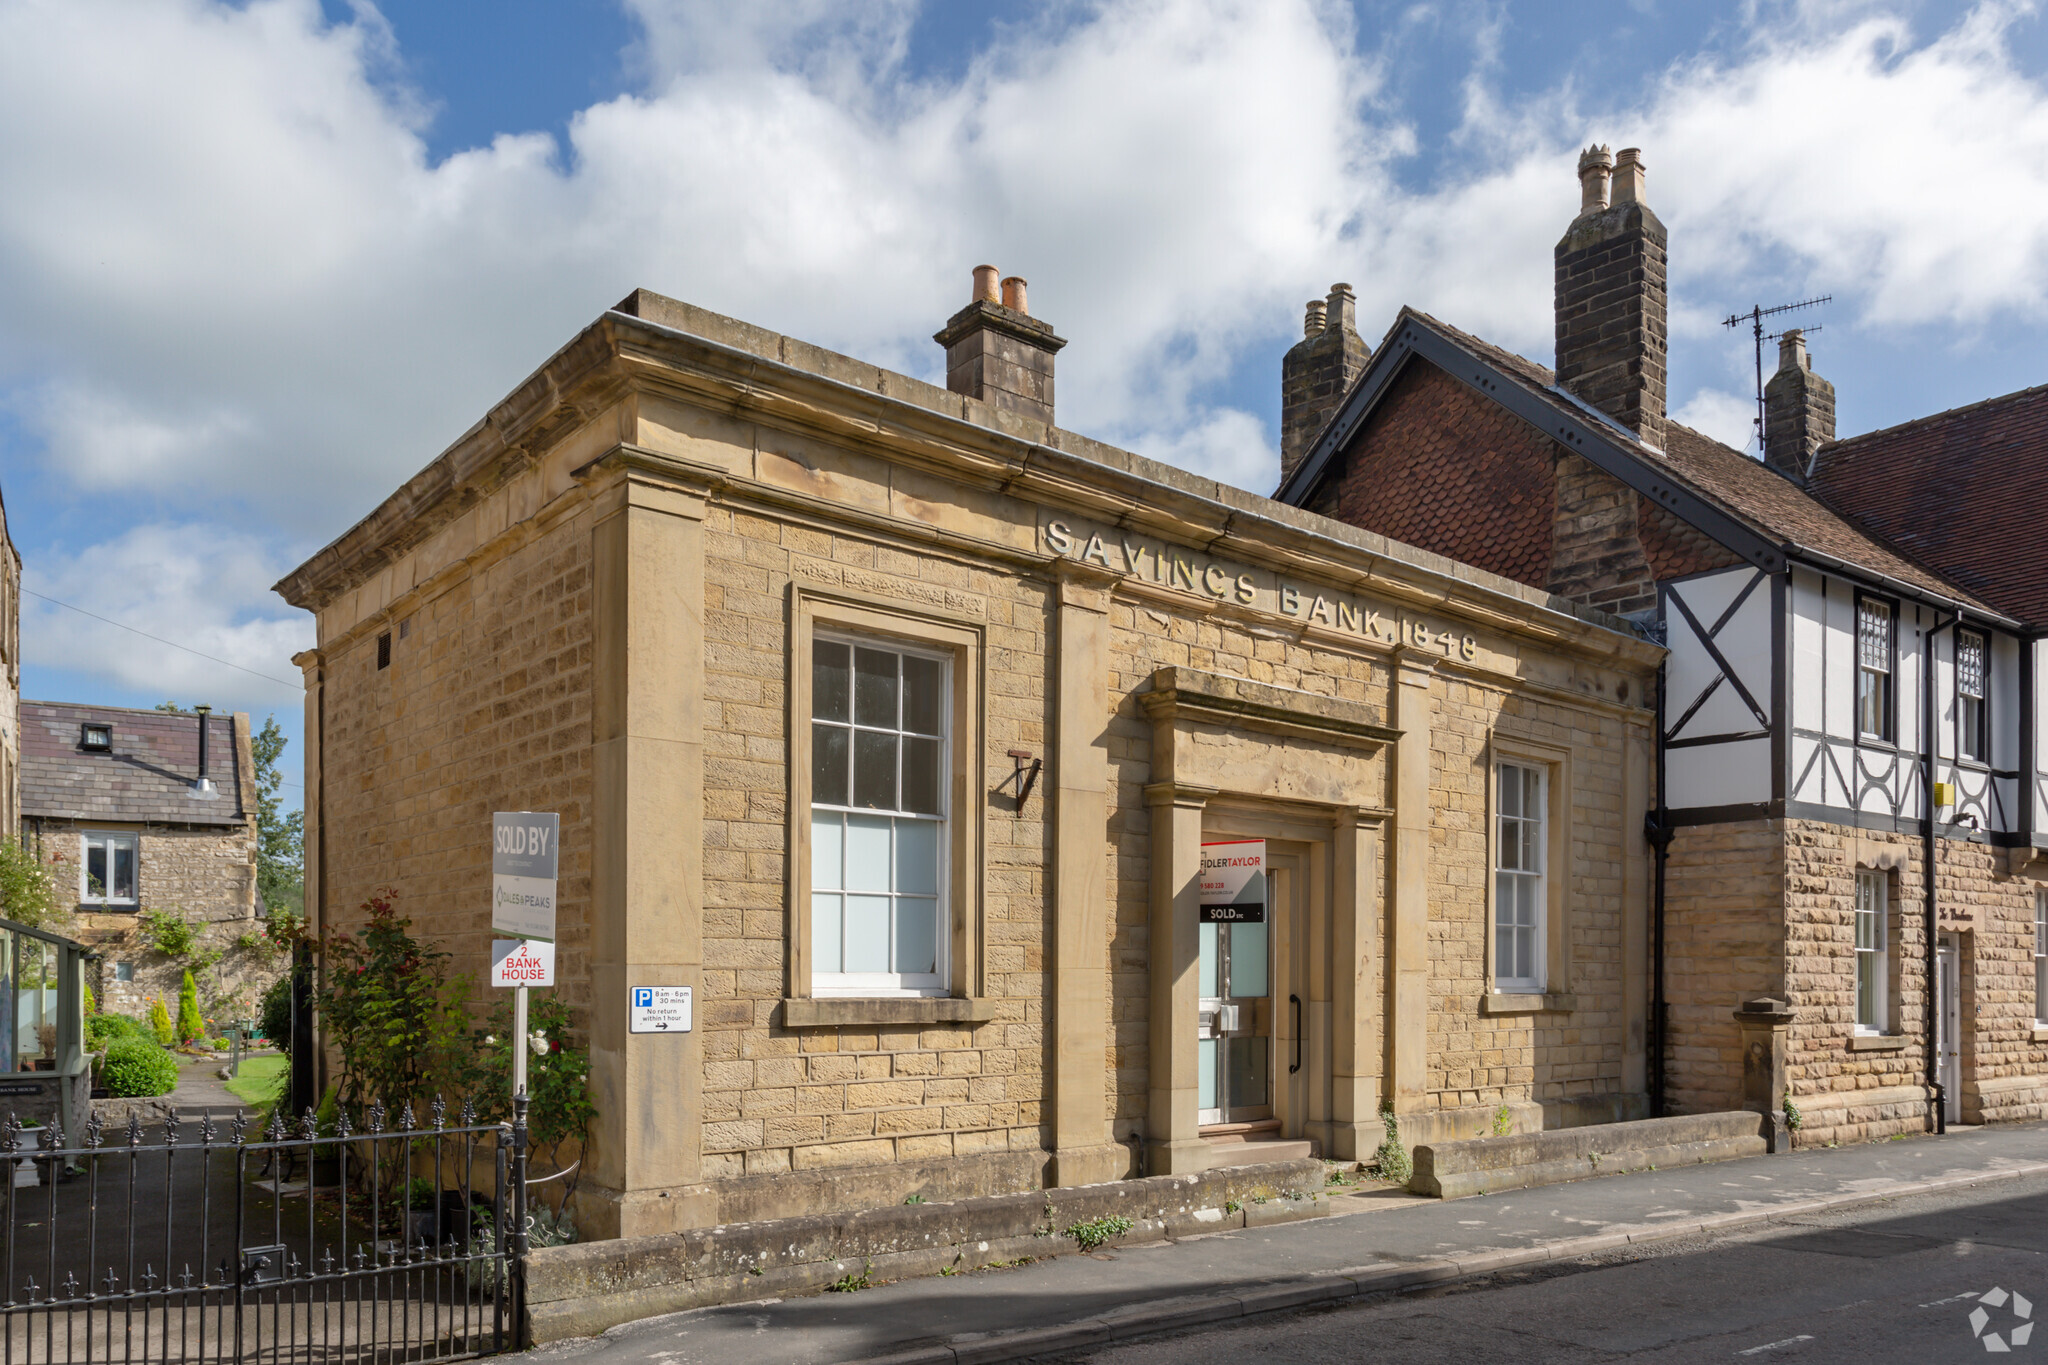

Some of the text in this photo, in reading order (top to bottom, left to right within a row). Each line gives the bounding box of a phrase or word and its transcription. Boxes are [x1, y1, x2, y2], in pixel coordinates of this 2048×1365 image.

[1046, 519, 1258, 603] SAVINGS
[1400, 615, 1477, 661] 1848
[496, 825, 550, 857] SOLD BY
[1210, 908, 1236, 919] SOLD
[520, 946, 528, 957] 2
[506, 957, 542, 969] BANK
[501, 968, 545, 980] HOUSE
[639, 990, 651, 1006] P
